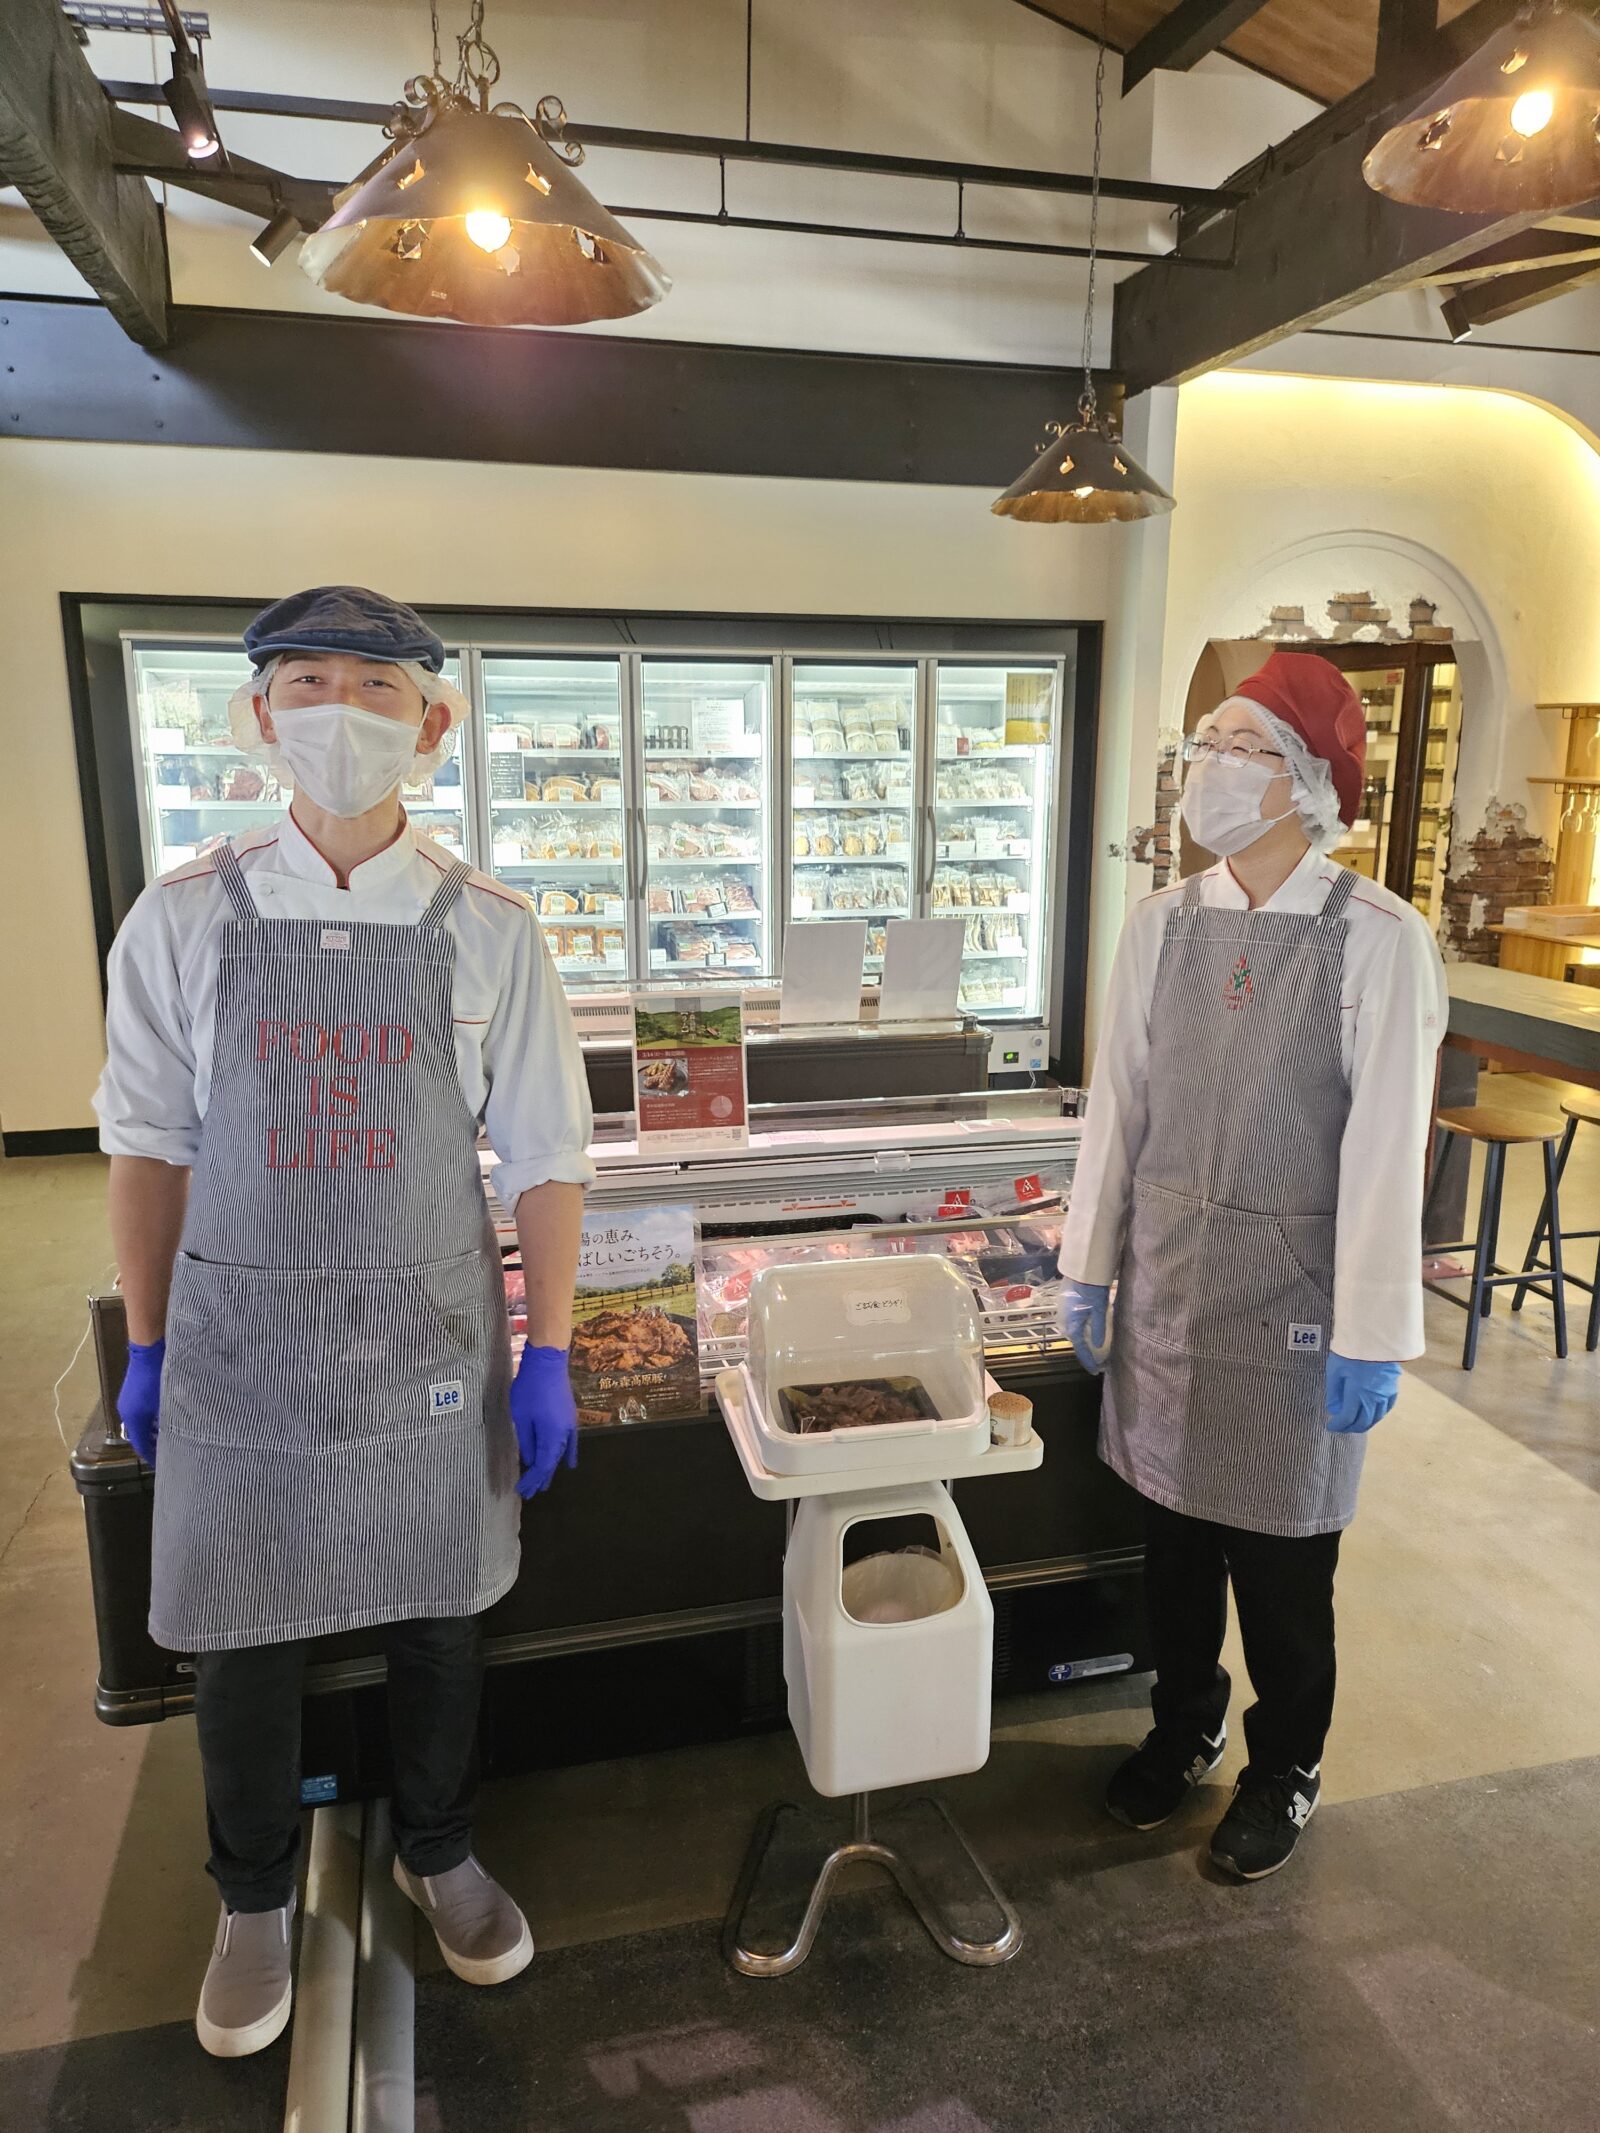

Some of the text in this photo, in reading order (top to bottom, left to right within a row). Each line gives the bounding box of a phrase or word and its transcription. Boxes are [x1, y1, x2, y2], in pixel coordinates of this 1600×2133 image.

[255, 1020, 413, 1065] FOOD
[305, 1075, 359, 1117] IS
[265, 1128, 396, 1169] LIFE
[1294, 1330, 1316, 1344] Lee
[435, 1390, 458, 1407] Lee
